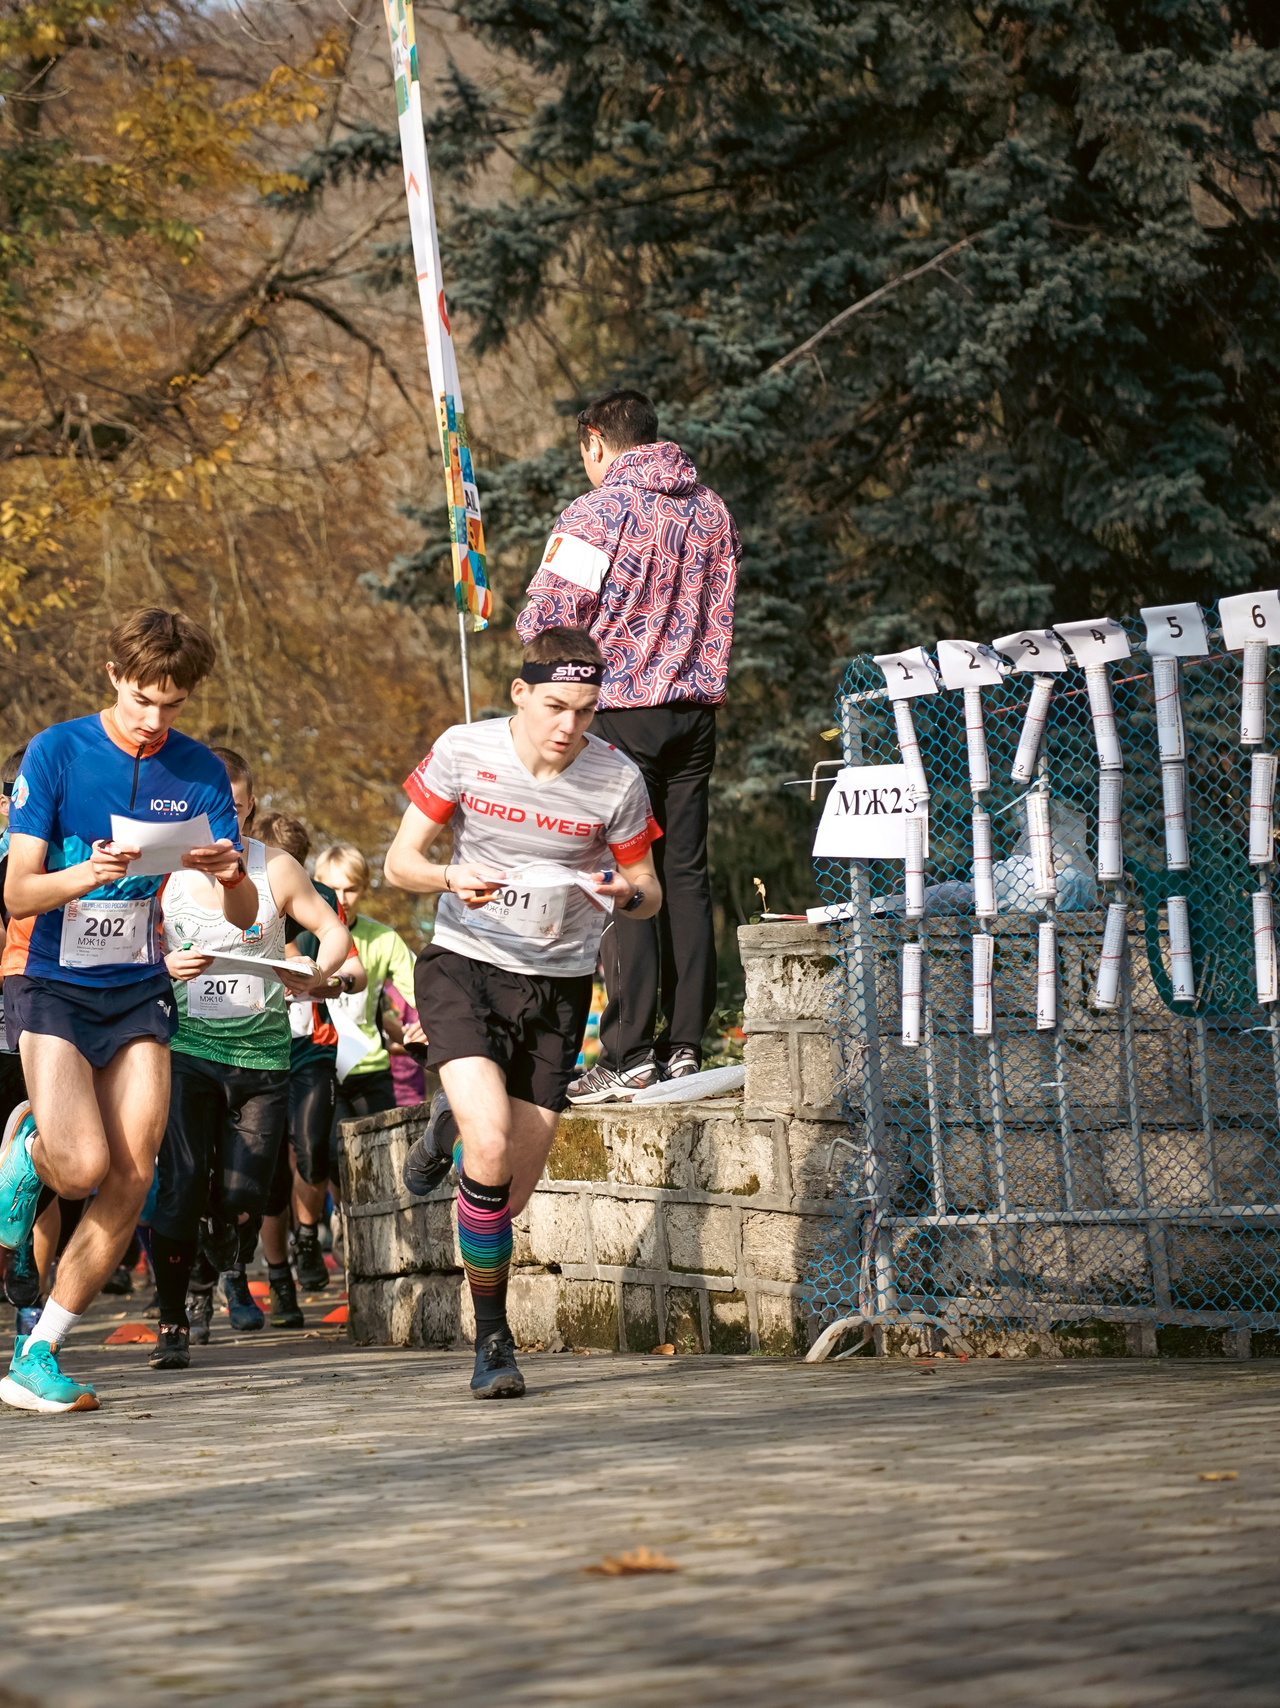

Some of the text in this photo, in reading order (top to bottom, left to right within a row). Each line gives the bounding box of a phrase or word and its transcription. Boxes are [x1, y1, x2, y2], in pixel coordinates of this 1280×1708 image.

[1251, 604, 1266, 628] 6
[1166, 616, 1183, 638] 5
[1089, 629, 1106, 645] 4
[1020, 639, 1040, 656] 3
[964, 649, 980, 669] 2
[897, 662, 913, 680] 1
[461, 793, 605, 837] NORD WEST
[84, 917, 125, 938] 202
[131, 926, 136, 938] 1
[77, 937, 106, 947] МЖ16
[203, 979, 239, 995] 207
